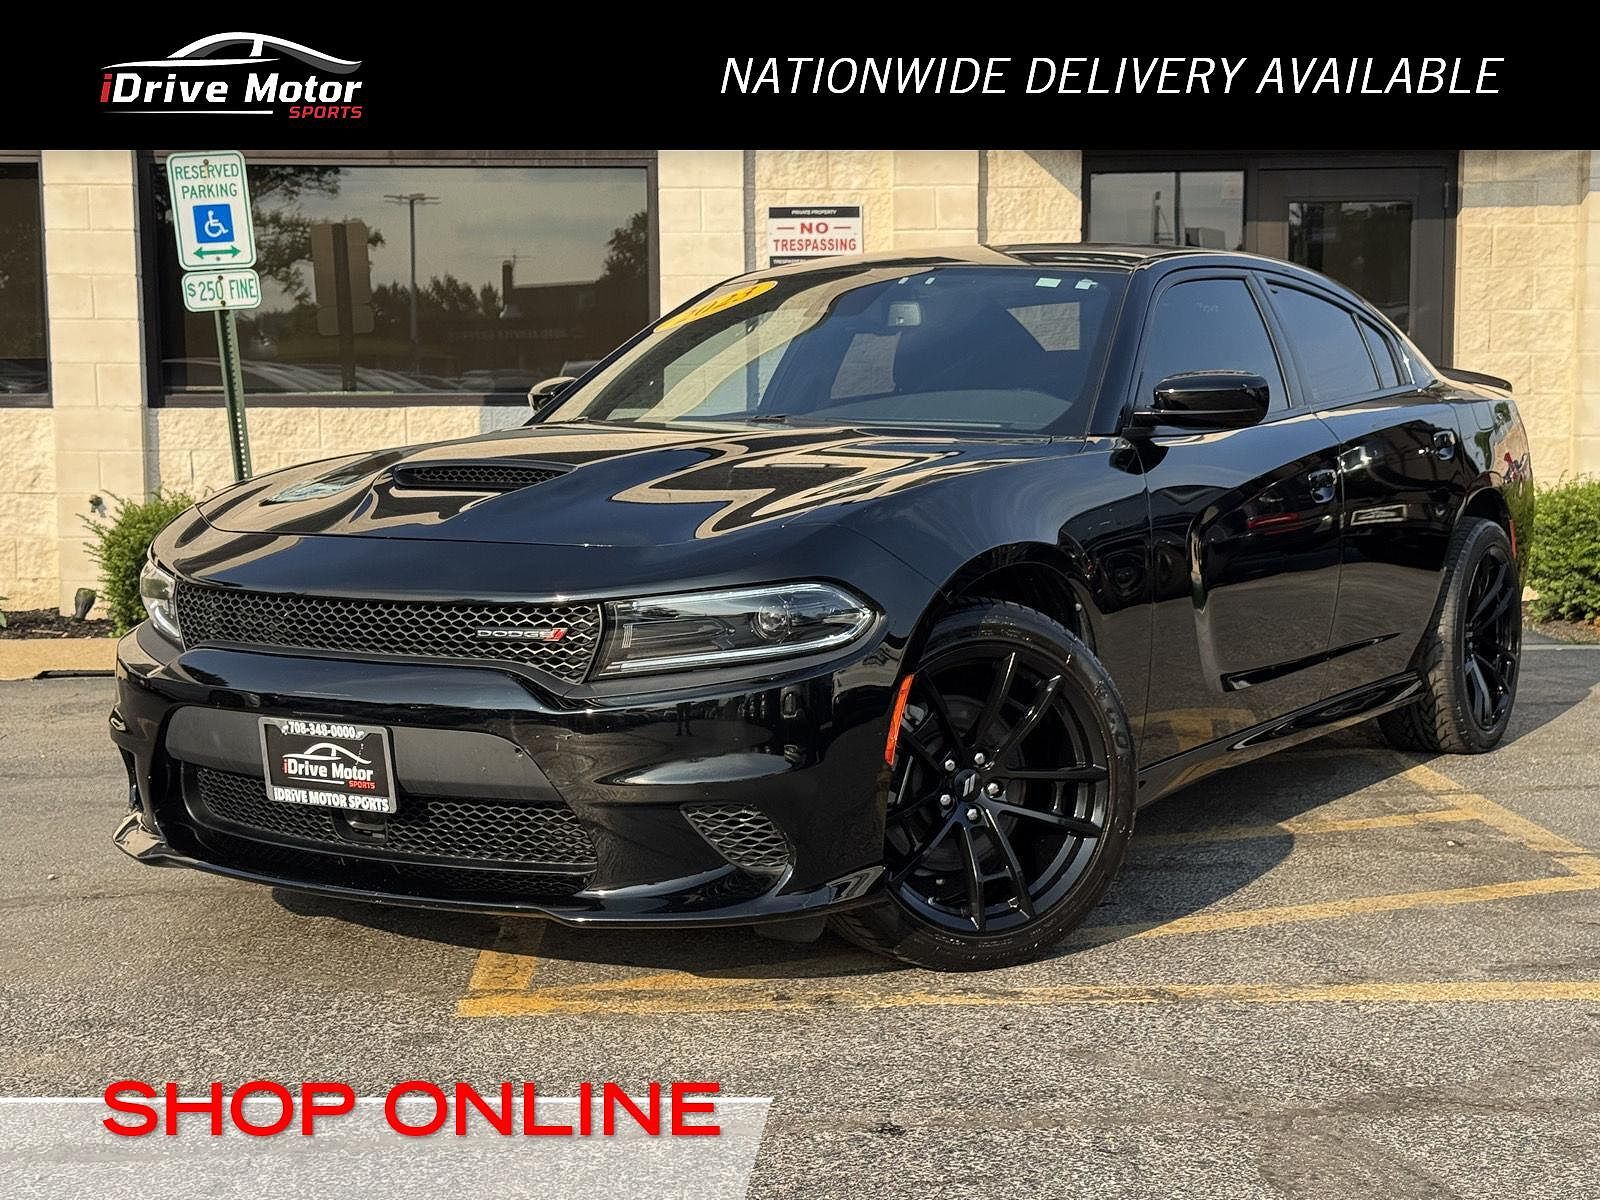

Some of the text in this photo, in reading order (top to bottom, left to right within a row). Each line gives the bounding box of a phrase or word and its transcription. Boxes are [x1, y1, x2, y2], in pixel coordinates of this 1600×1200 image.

[175, 164, 239, 180] RESERVED
[182, 183, 238, 199] PARKING
[800, 222, 829, 234] NO
[773, 238, 857, 252] TRESPASSING
[187, 278, 257, 301] $250 FINE
[477, 629, 551, 639] DODGE
[288, 721, 356, 739] 708-348-0000
[283, 758, 374, 781] iDrive Motor
[348, 780, 375, 790] SPORTS
[308, 790, 348, 808] MOTOR
[348, 795, 390, 812] SPORTS
